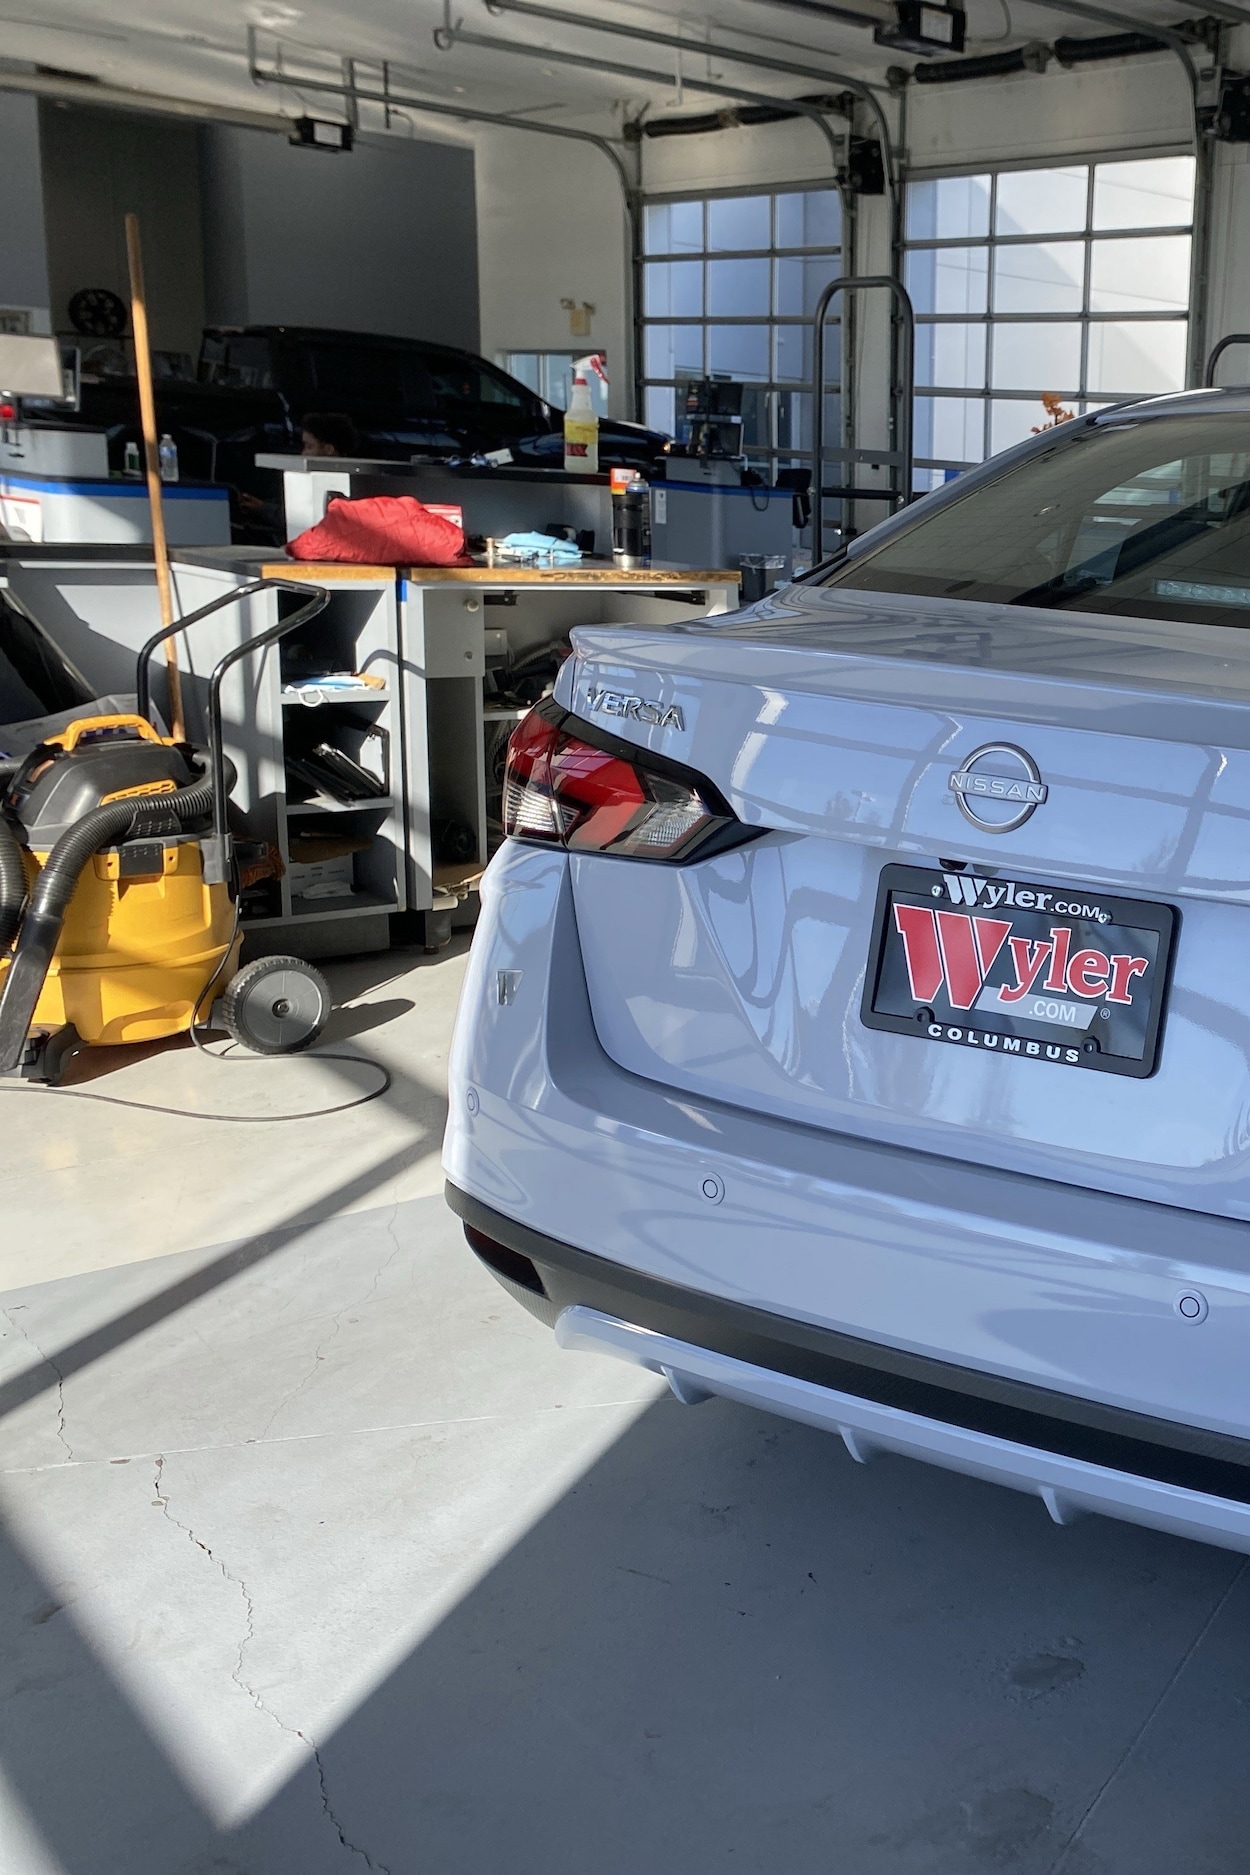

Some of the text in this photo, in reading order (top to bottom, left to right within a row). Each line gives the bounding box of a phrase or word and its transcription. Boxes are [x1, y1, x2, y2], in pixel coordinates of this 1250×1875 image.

[586, 687, 685, 731] VERSA
[950, 774, 1044, 800] NISSAN
[893, 903, 1149, 1011] Wyler
[927, 1023, 1080, 1062] COLUMBUS
